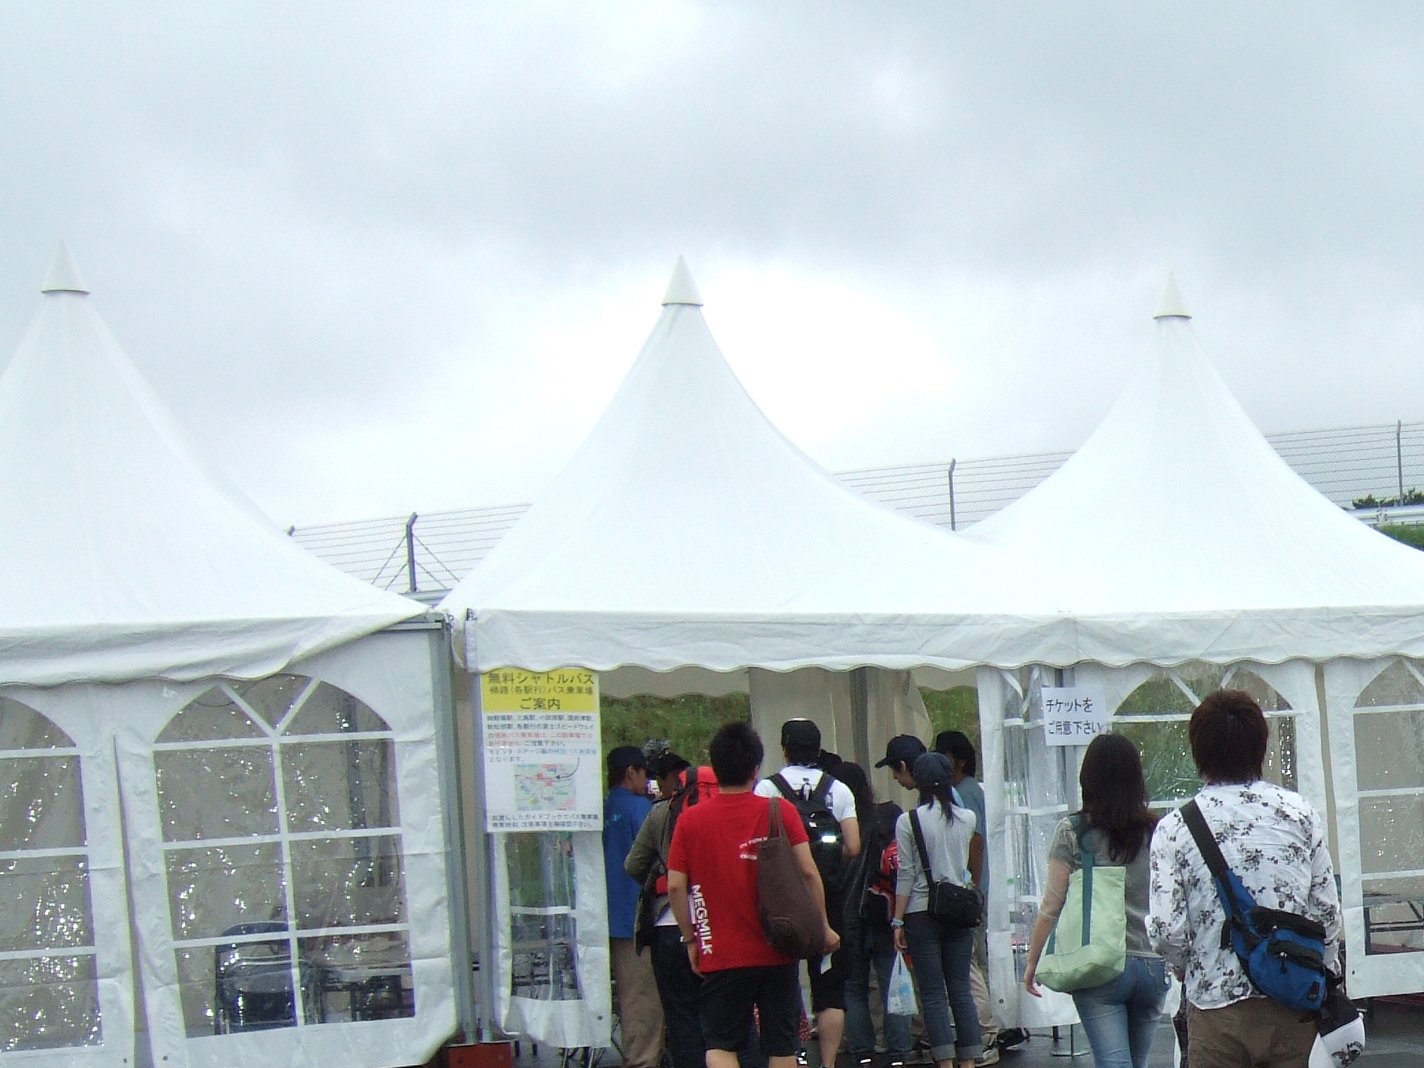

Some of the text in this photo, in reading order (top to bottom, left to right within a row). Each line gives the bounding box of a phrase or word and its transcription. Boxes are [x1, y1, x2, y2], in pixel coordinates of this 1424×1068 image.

[488, 672, 594, 684] 無料シャトルバス
[520, 698, 561, 710] ご案内
[1046, 697, 1093, 713] チケットを
[1048, 720, 1102, 735] ご用意下さい
[691, 884, 713, 955] MEGMILK
